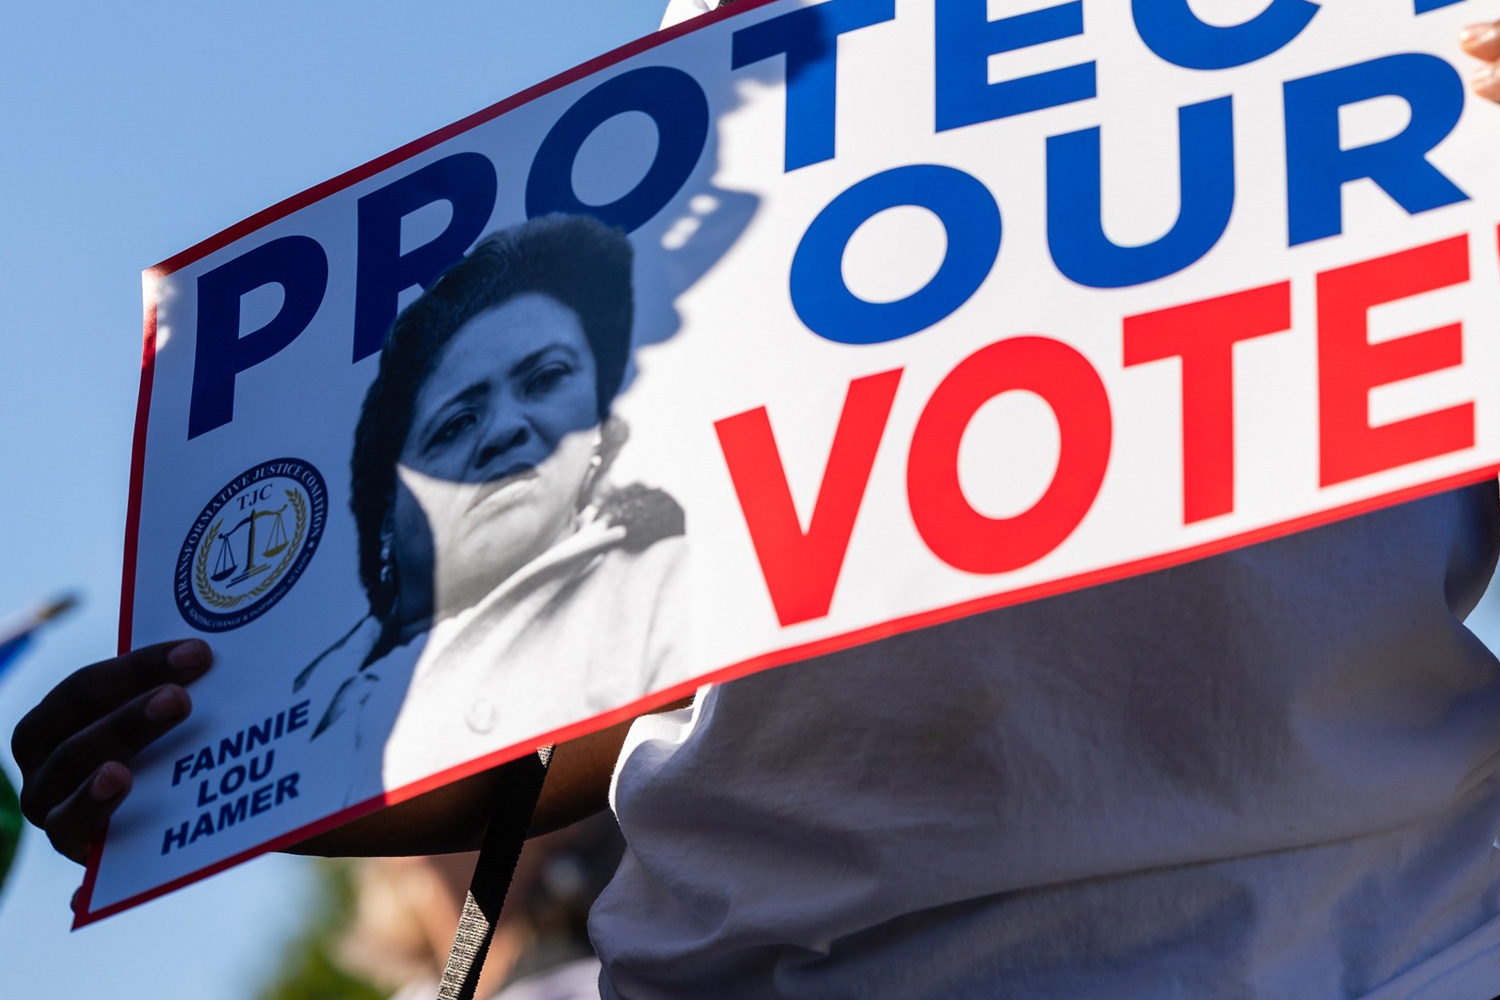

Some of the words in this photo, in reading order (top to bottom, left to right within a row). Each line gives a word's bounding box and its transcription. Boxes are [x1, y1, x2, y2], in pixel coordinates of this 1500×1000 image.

[790, 51, 1473, 346] OUR
[178, 474, 250, 599] TRANSFORMATIVE
[252, 463, 304, 480] JUSTICE
[301, 470, 325, 537] COALITION
[236, 483, 273, 512] TJC
[172, 699, 311, 788] FANNIE
[197, 749, 275, 808] LOU
[161, 772, 300, 856] HAMER
